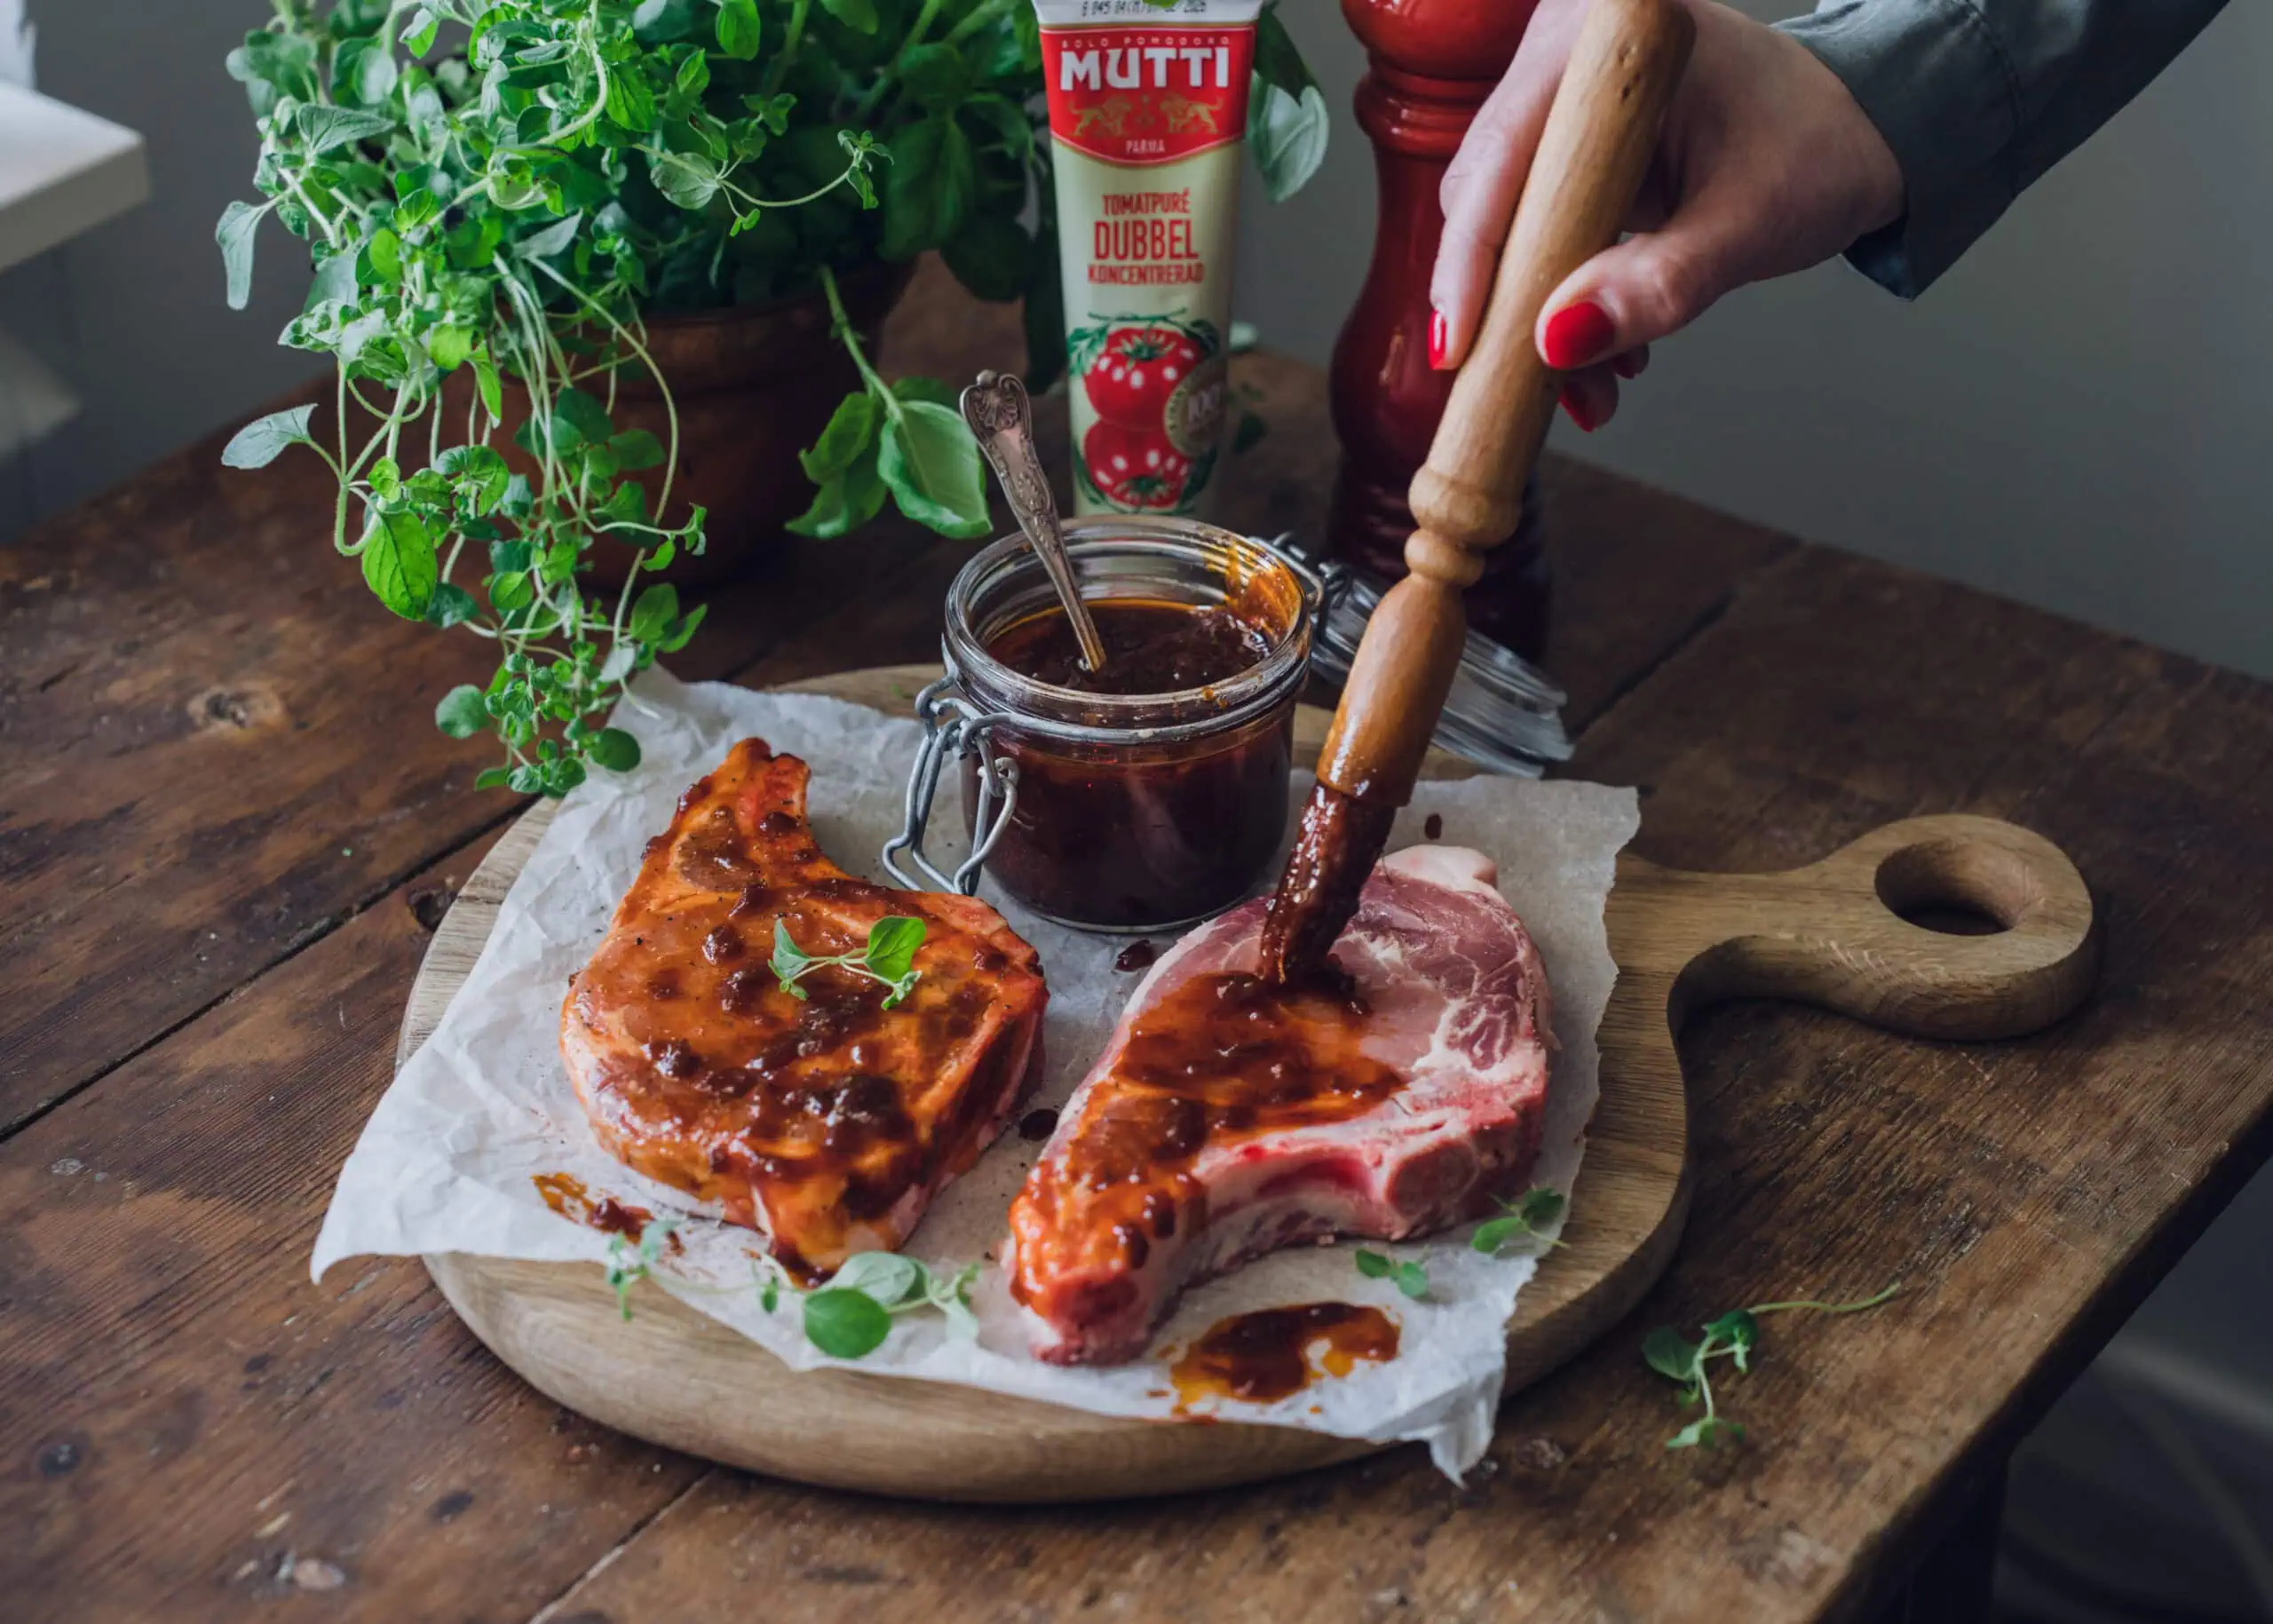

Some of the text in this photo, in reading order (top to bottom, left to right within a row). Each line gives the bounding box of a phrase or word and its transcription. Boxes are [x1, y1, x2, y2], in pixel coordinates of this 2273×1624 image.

[1062, 36, 1230, 48] SOLO POMODORO
[1060, 47, 1230, 91] MUTTI
[1126, 139, 1165, 153] PARMA
[1102, 188, 1191, 215] TOMATPURÉ
[1095, 220, 1199, 260] DUBBEL
[1089, 265, 1204, 285] KONCENTRERAD
